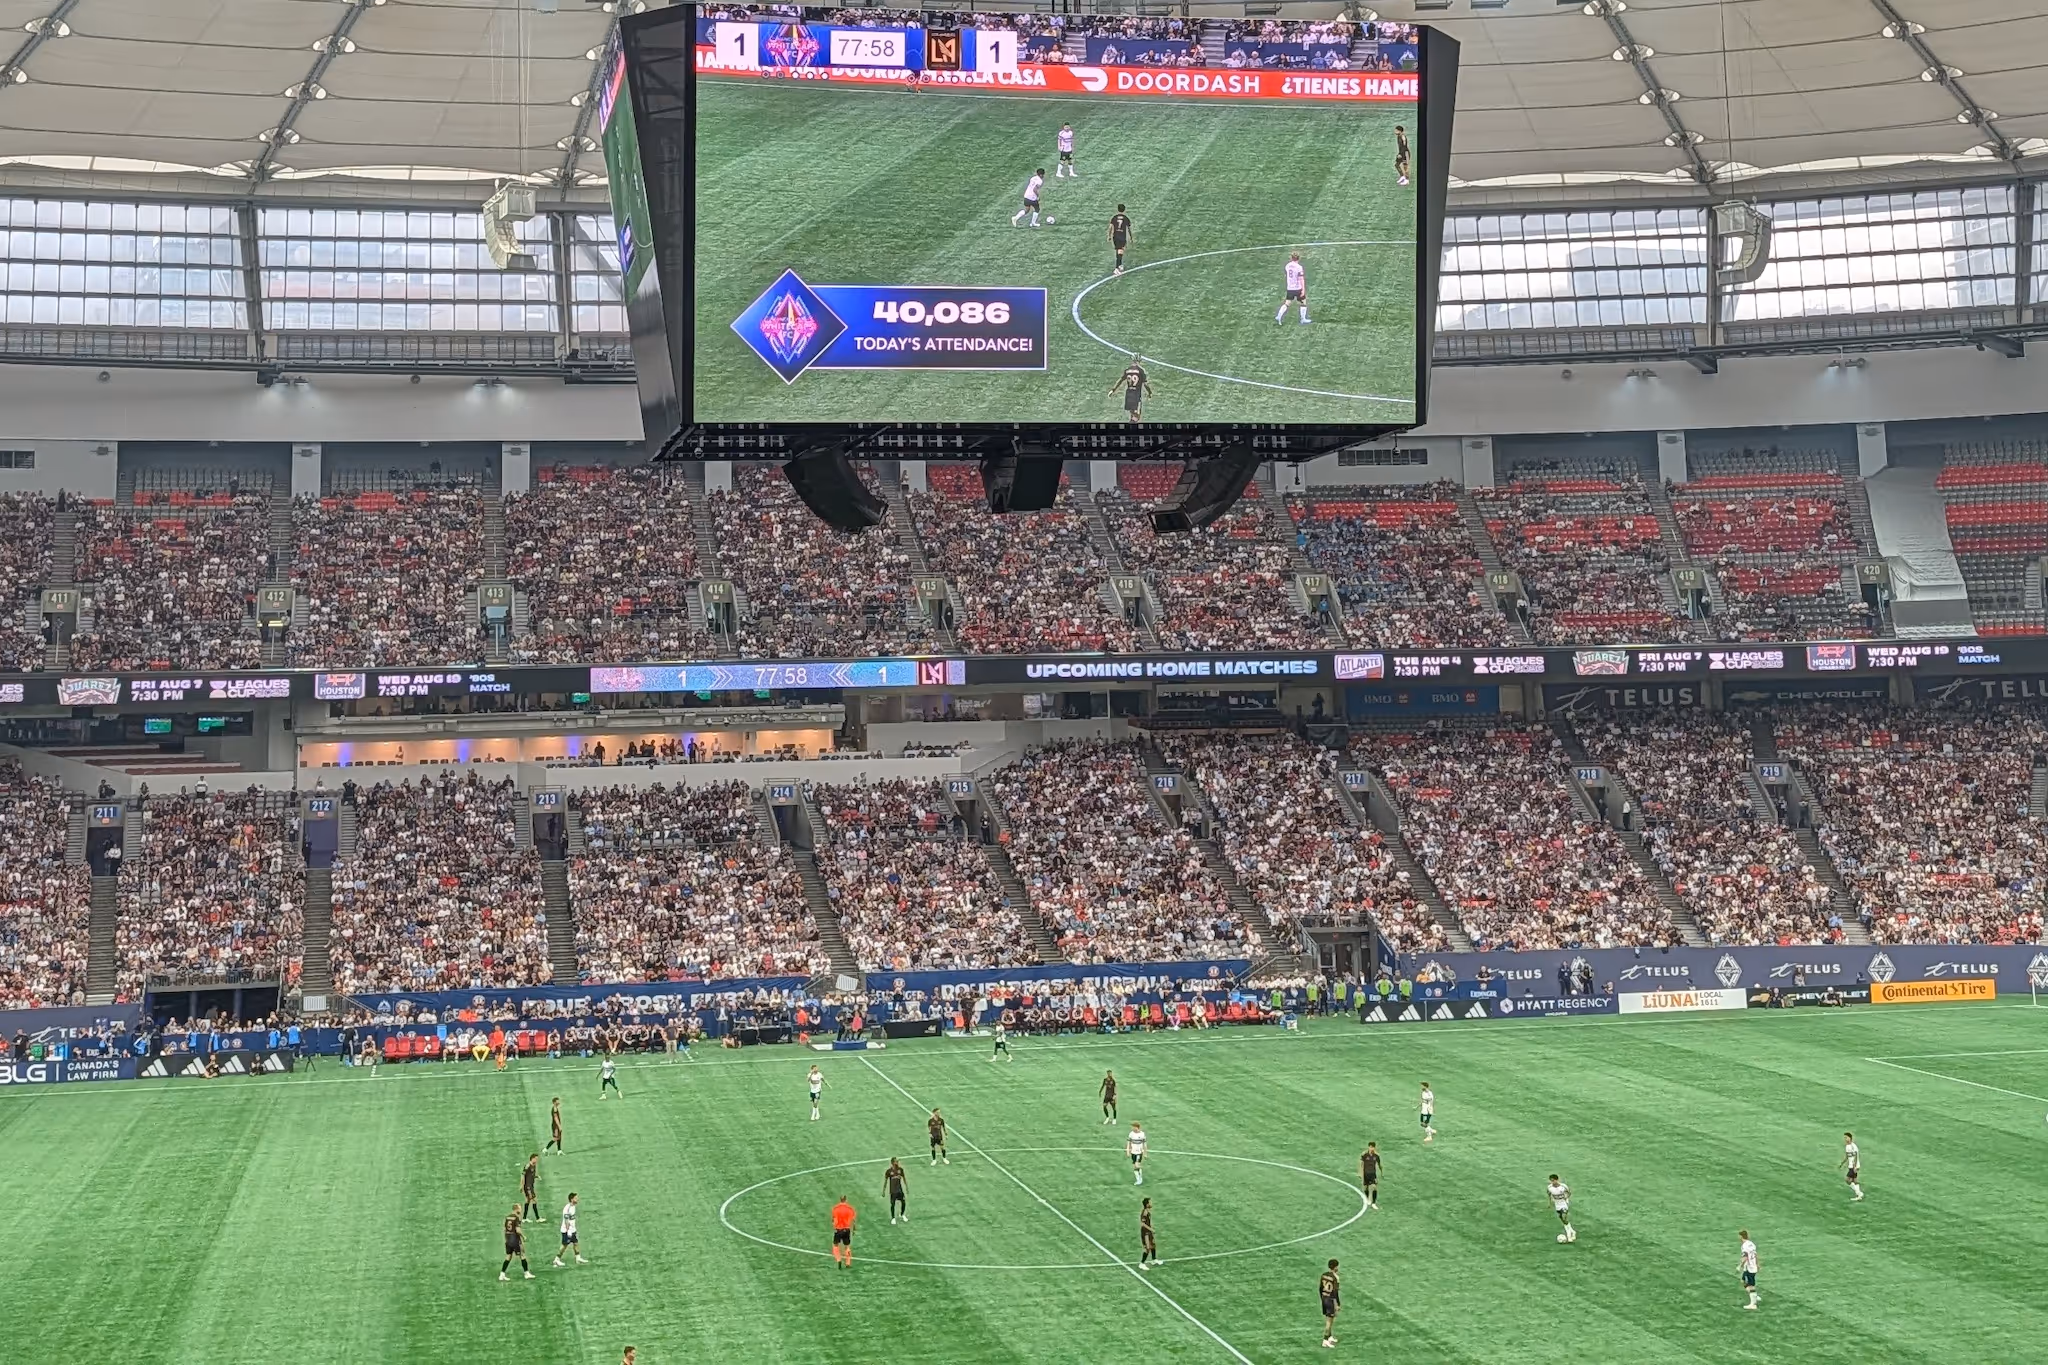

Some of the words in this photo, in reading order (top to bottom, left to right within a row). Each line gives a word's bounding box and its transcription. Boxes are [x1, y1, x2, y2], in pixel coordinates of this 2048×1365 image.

[734, 33, 745, 56] 1
[837, 38, 895, 57] 77:58
[989, 41, 1000, 63] 1
[1118, 72, 1260, 93] DOORDASH
[1281, 77, 1361, 95] ¿TIENES
[872, 300, 1010, 326] 40,086
[854, 336, 921, 352] TODAY'S
[925, 336, 1033, 352] ATTENDANCE!
[1679, 571, 1695, 581] 419
[1864, 566, 1880, 576] 420
[1119, 579, 1134, 589] 416
[1305, 577, 1320, 587] 417
[1493, 575, 1508, 585] 418
[707, 584, 724, 594] 414
[921, 581, 936, 591] 415
[51, 593, 68, 603] 411
[268, 591, 284, 602] 412
[487, 588, 504, 598] 413
[1638, 652, 1660, 661] FRI
[1663, 652, 1692, 661] AUG
[1693, 652, 1703, 661] 7
[1725, 651, 1784, 661] LEAGUES
[1867, 647, 1898, 656] WED
[1902, 646, 1931, 656] AUG
[1934, 646, 1950, 655] 19
[1340, 657, 1380, 672] ATLANTE
[1393, 657, 1419, 665] TUE
[1421, 656, 1450, 665] AUG
[1452, 656, 1462, 665] 4
[1489, 656, 1545, 665] LEAGUES
[1812, 658, 1851, 666] HOUSTON
[1868, 657, 1895, 667] 7:30
[1898, 656, 1917, 666] PM
[1958, 655, 2000, 663] MATCH
[1027, 663, 1142, 678] UPCOMING
[1146, 662, 1210, 677] HOME
[1214, 660, 1318, 676] MATCHES
[1394, 666, 1419, 677] 7:30
[1422, 666, 1441, 676] PM
[1638, 662, 1664, 672] 7:30
[1668, 661, 1686, 672] PM
[378, 675, 410, 684] WED
[413, 674, 444, 684] AUG
[677, 671, 687, 687] 1
[755, 667, 807, 686] 77:58
[877, 666, 888, 683] 1
[131, 680, 156, 690] FRI
[159, 679, 191, 689] AUG
[228, 679, 290, 689] LEAGUES
[469, 683, 511, 692] MATCH
[131, 690, 159, 701] 7:30
[163, 690, 184, 700] PM
[319, 686, 360, 695] HOUSTON
[378, 685, 405, 696] 7:30
[409, 685, 429, 695] PM
[1776, 690, 1884, 699] CHEVROLET
[1364, 694, 1392, 704] BMO
[1432, 693, 1459, 703] BMO
[1605, 687, 1694, 706] TELUS
[1580, 769, 1597, 780] 218
[1763, 766, 1780, 777] 219
[1157, 777, 1173, 788] 216
[1345, 773, 1362, 784] 217
[773, 787, 790, 797] 214
[952, 782, 968, 792] 215
[538, 794, 556, 804] 213
[312, 801, 330, 811] 212
[96, 807, 114, 818] 211
[1498, 969, 1542, 980] TELUS
[1645, 966, 1689, 977] TELUS
[1951, 964, 1999, 974] TELUS
[1699, 991, 1723, 999] LOCAL
[1787, 990, 1868, 1000] CHEVLET
[1882, 983, 1948, 1001] Continental
[1957, 982, 1986, 995] Tire
[1517, 1000, 1555, 1010] HYATT
[1557, 998, 1609, 1009] REGENCY
[1642, 993, 1699, 1008] LiUNA!
[67, 1060, 119, 1071] CANADA'S
[0, 1063, 47, 1084] BLG
[67, 1072, 89, 1081] LAW
[92, 1070, 118, 1079] FIRM
